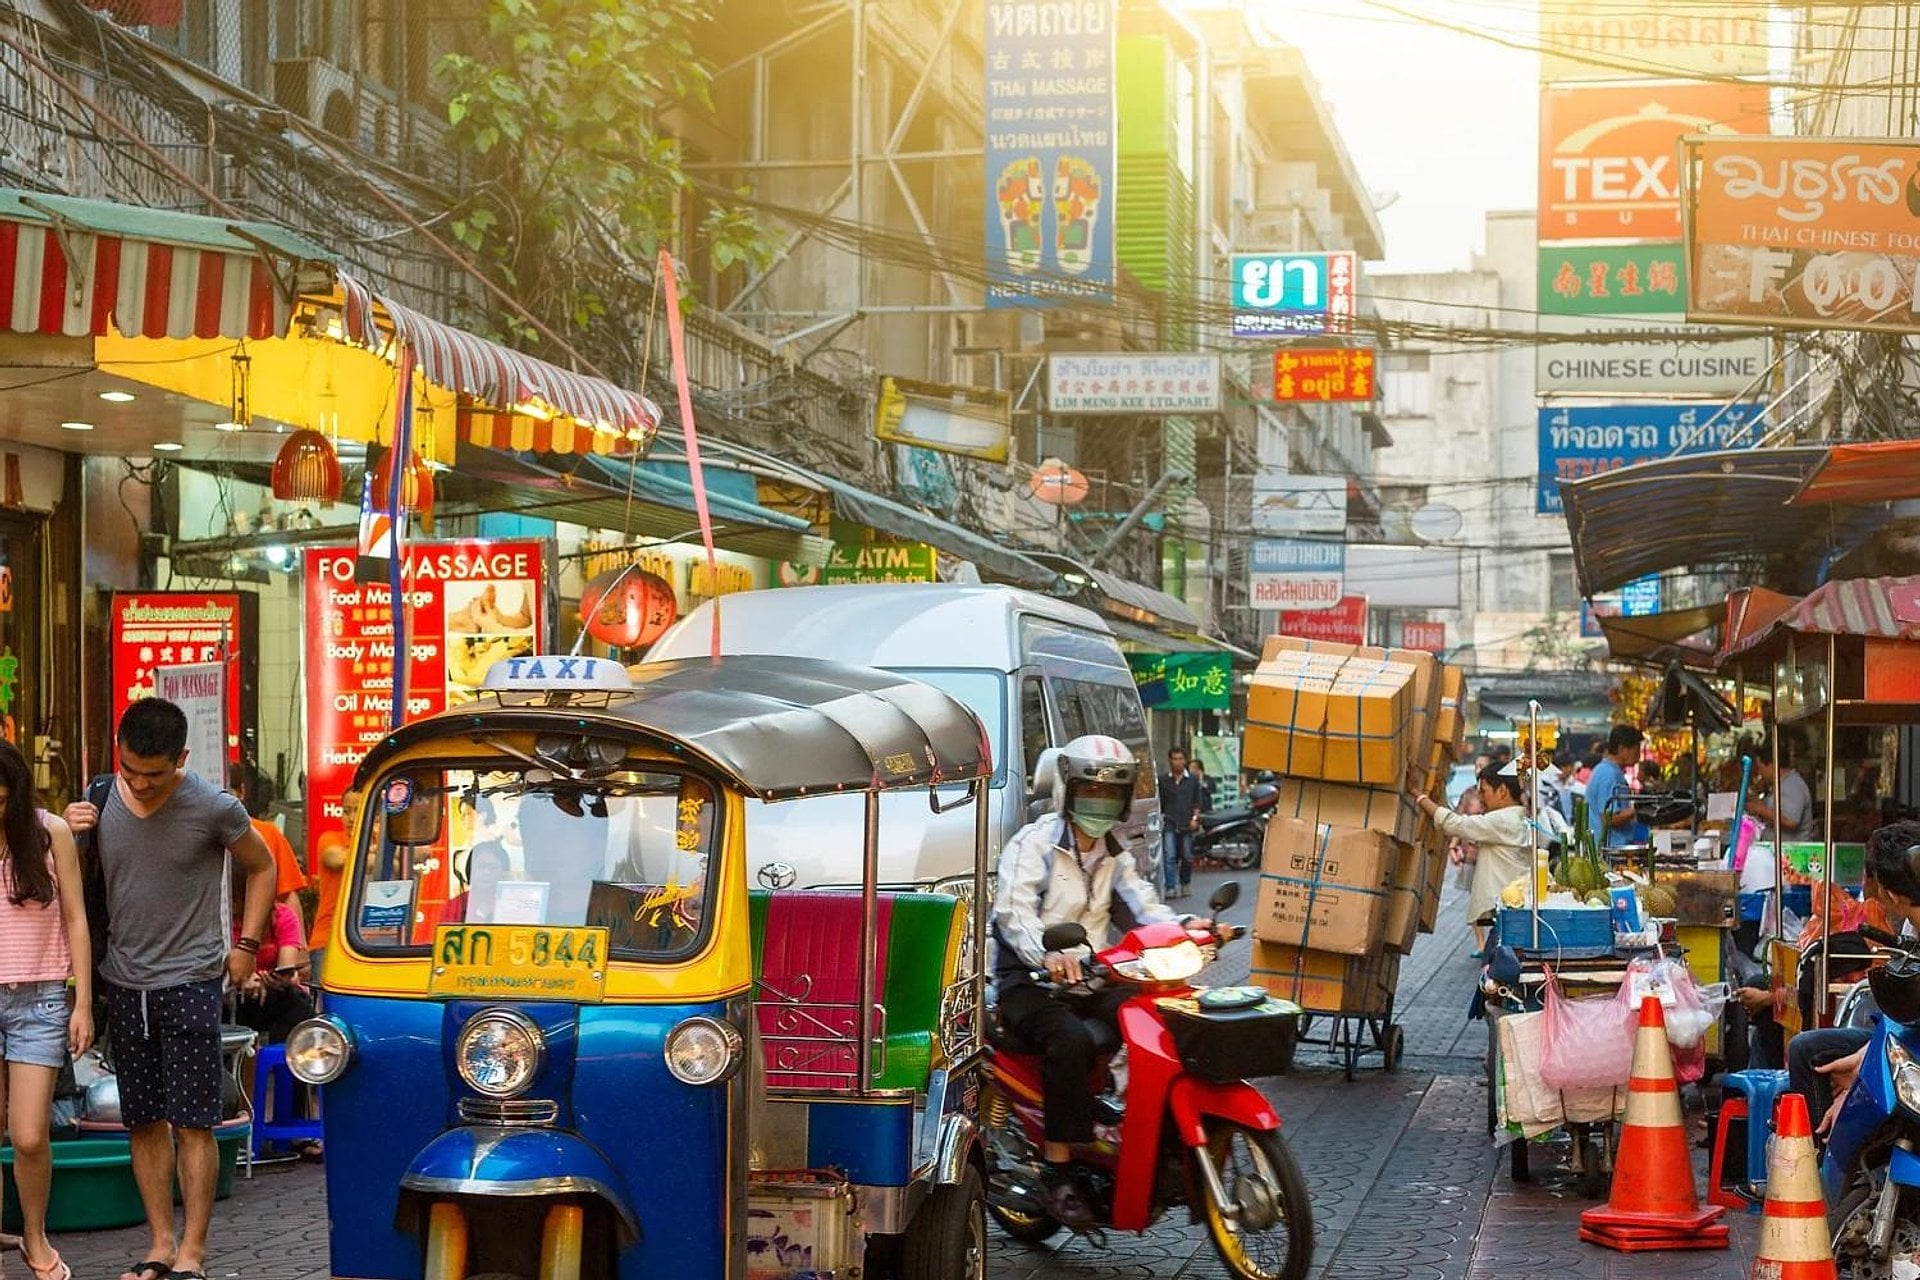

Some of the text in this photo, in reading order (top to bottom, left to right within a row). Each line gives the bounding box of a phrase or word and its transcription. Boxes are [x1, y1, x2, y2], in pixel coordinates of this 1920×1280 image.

[1031, 77, 1108, 96] MASSAGE
[1713, 154, 1905, 222] มธุรส
[1741, 224, 1789, 241] THAI
[1797, 227, 1879, 248] CHINESE
[1242, 259, 1319, 307] ยา
[1547, 357, 1757, 379] CHINESE CUISINE
[1055, 396, 1077, 408] LIM
[1121, 396, 1144, 408] KEE
[1550, 408, 1659, 450] ที่จอดรถ
[855, 547, 910, 569] ATM
[328, 589, 361, 605] Foot
[326, 640, 365, 661] Body
[506, 658, 597, 680] TAXI
[1169, 665, 1227, 695] 如意
[182, 672, 218, 699] MASSAGE
[334, 692, 357, 711] Oil
[442, 927, 598, 969] สก 5844
